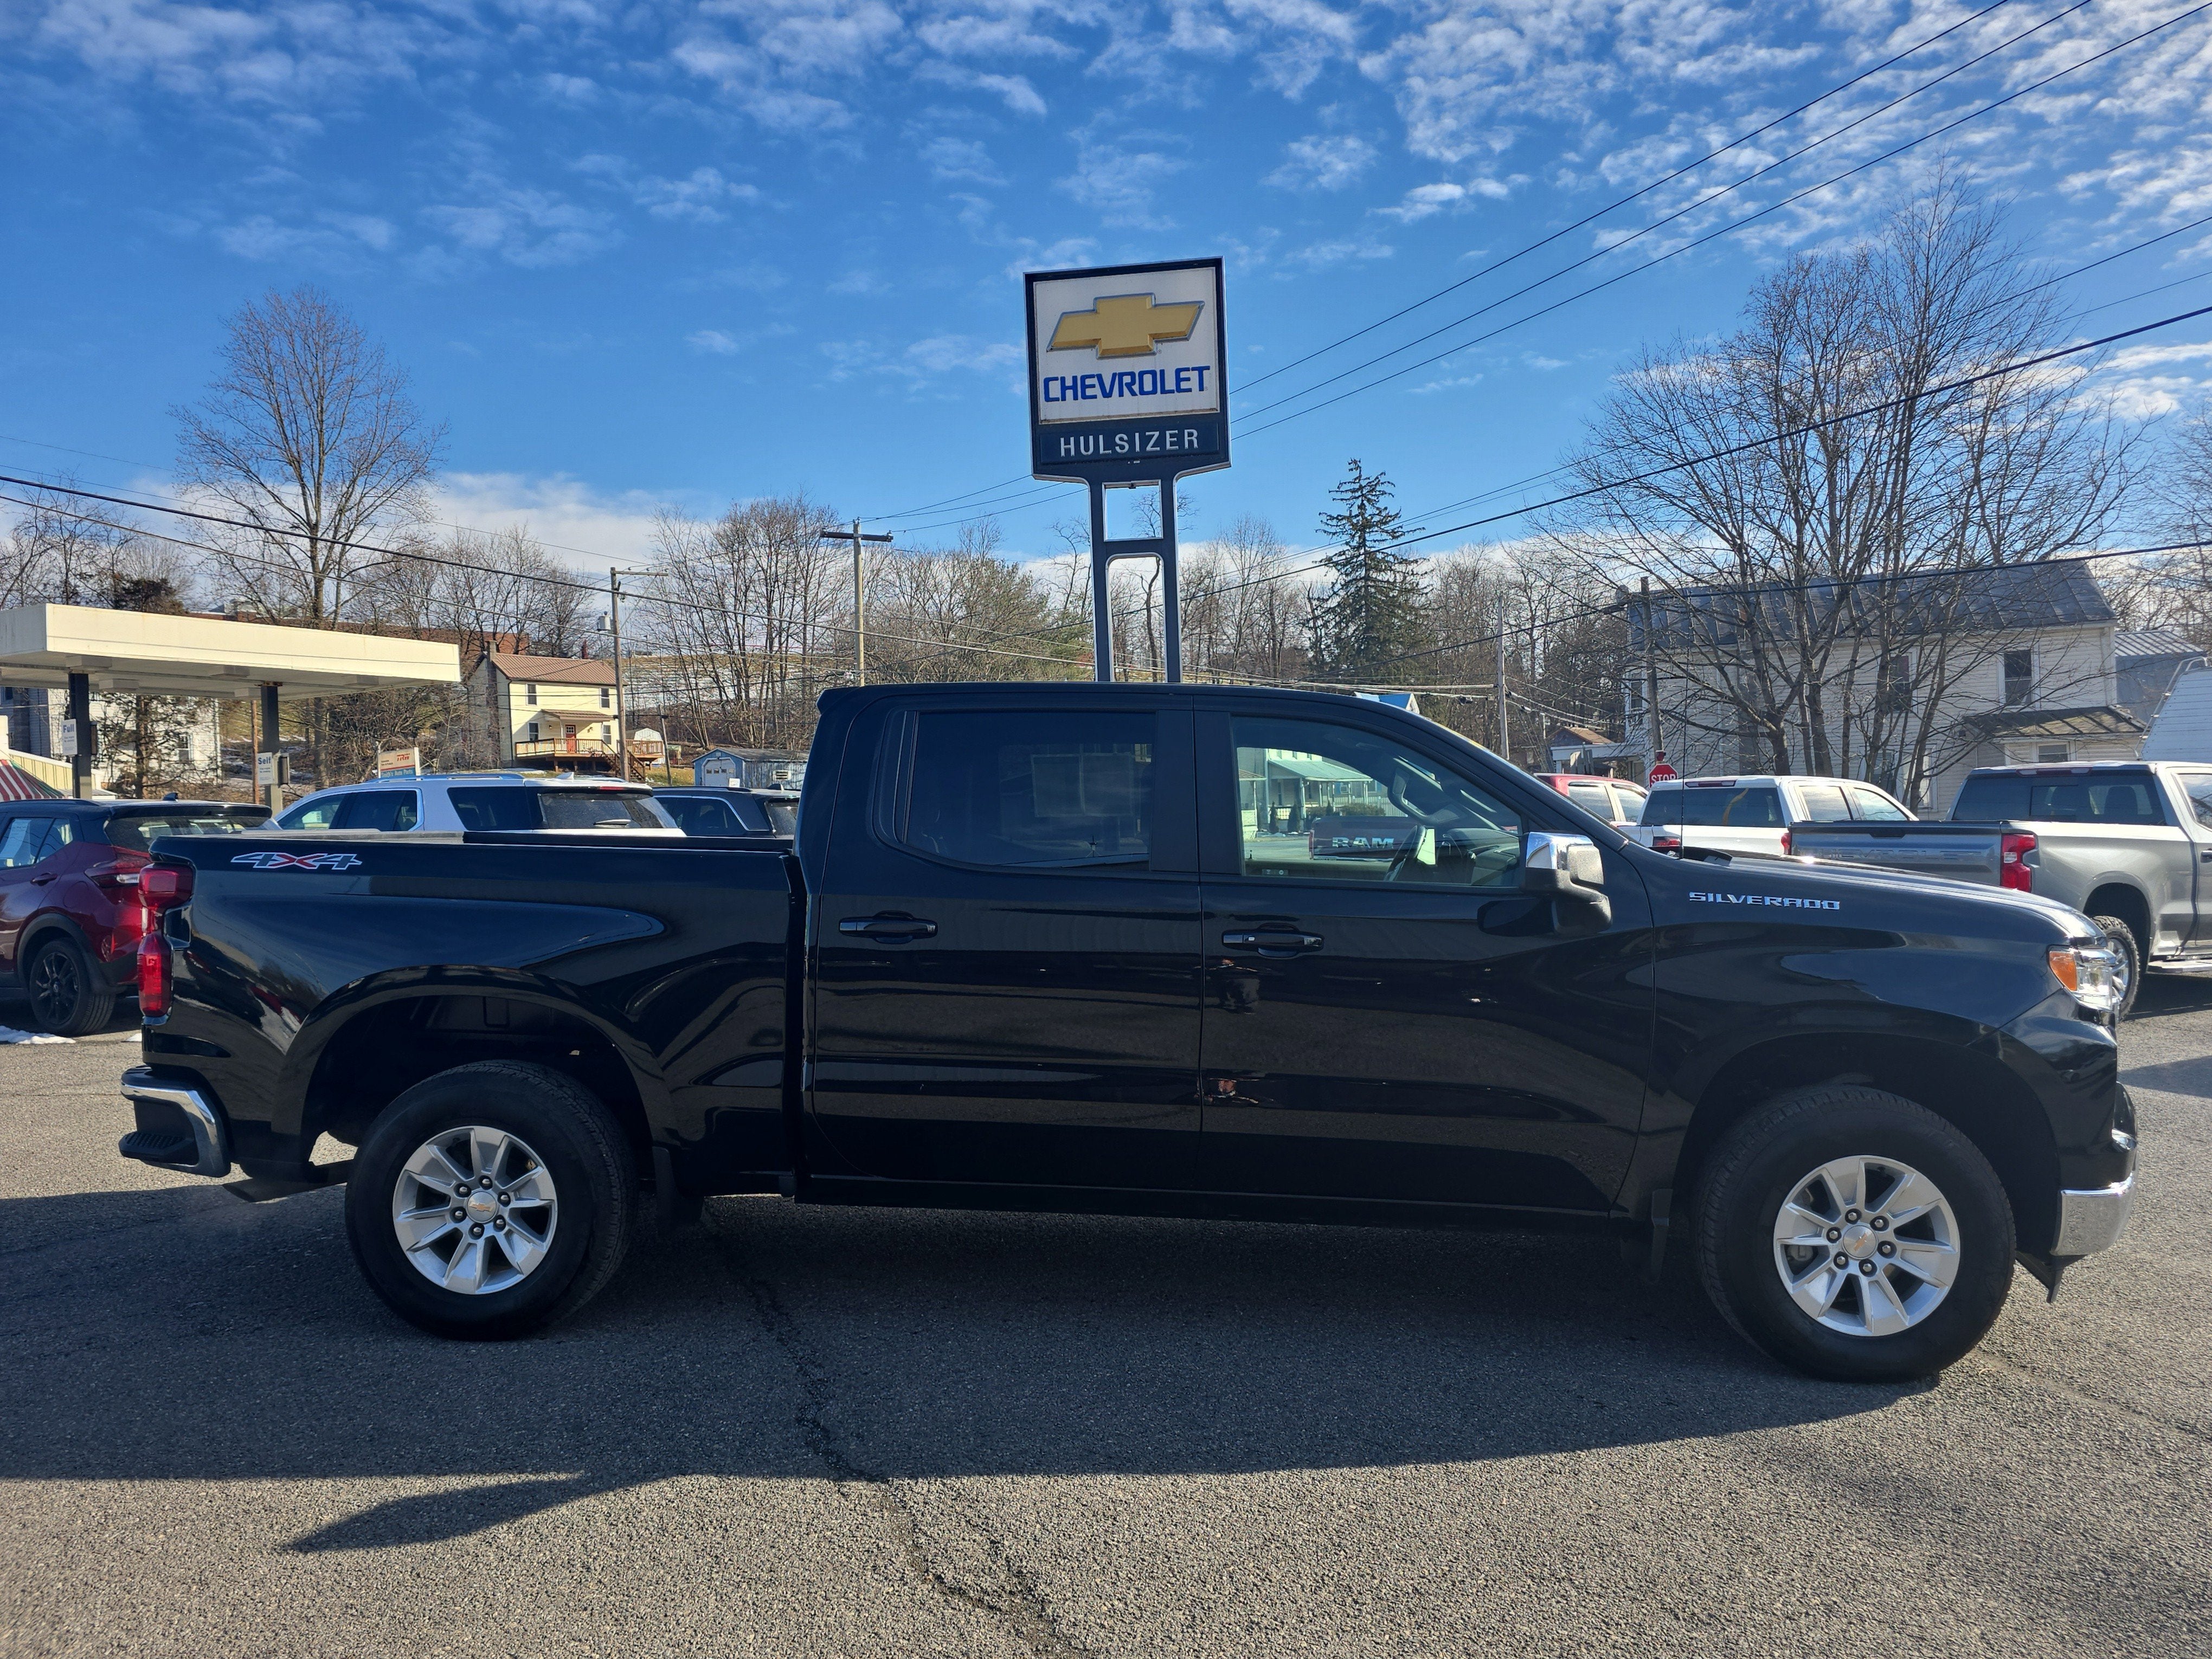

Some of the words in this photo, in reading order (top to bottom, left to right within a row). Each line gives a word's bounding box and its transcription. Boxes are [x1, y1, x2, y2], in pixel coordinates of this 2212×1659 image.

[1044, 365, 1211, 402] CHEVROLET
[1060, 429, 1198, 457] HULSIZER
[63, 723, 74, 733] Full
[258, 756, 271, 764] Self
[1651, 774, 1676, 785] STOP
[1332, 837, 1394, 848] RAM
[1689, 892, 1840, 910] SILVERADO
